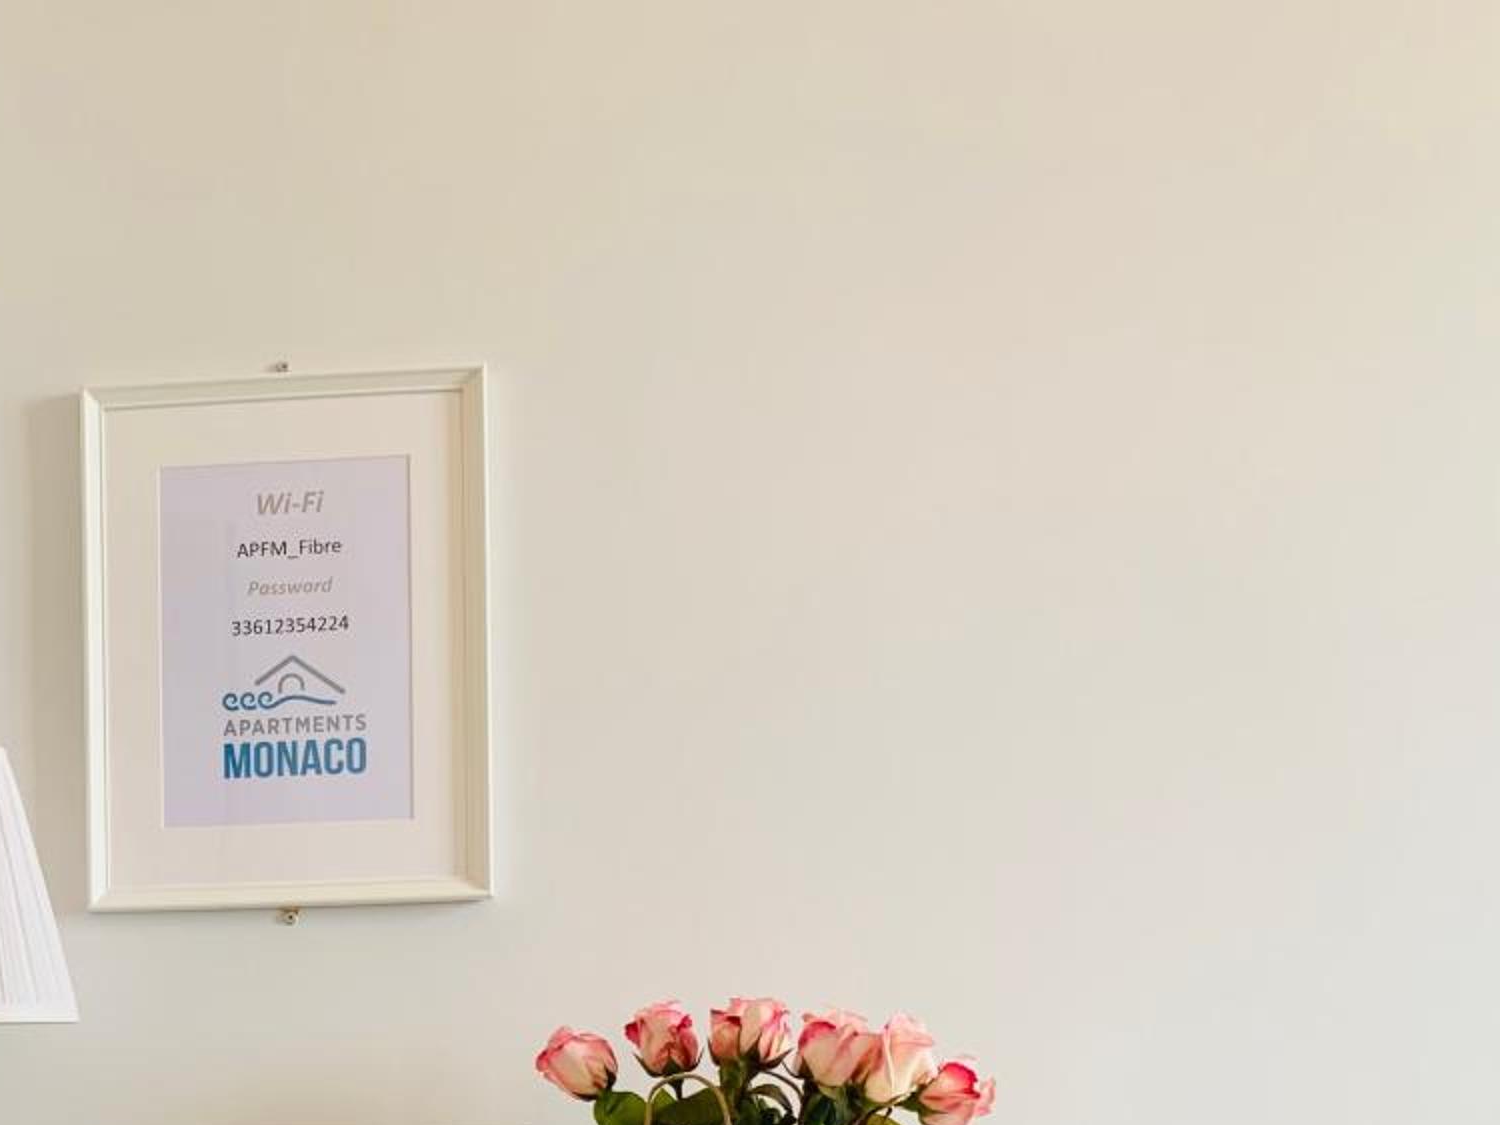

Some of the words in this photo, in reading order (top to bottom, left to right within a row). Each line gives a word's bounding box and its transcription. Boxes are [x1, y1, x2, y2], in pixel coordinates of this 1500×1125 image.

[257, 490, 324, 516] Wi-Fi
[236, 538, 343, 560] APFM_Fibre
[247, 576, 334, 597] Password
[231, 615, 350, 637] 33612354224
[224, 714, 367, 737] APARTMENTS
[223, 738, 367, 779] MONACO
